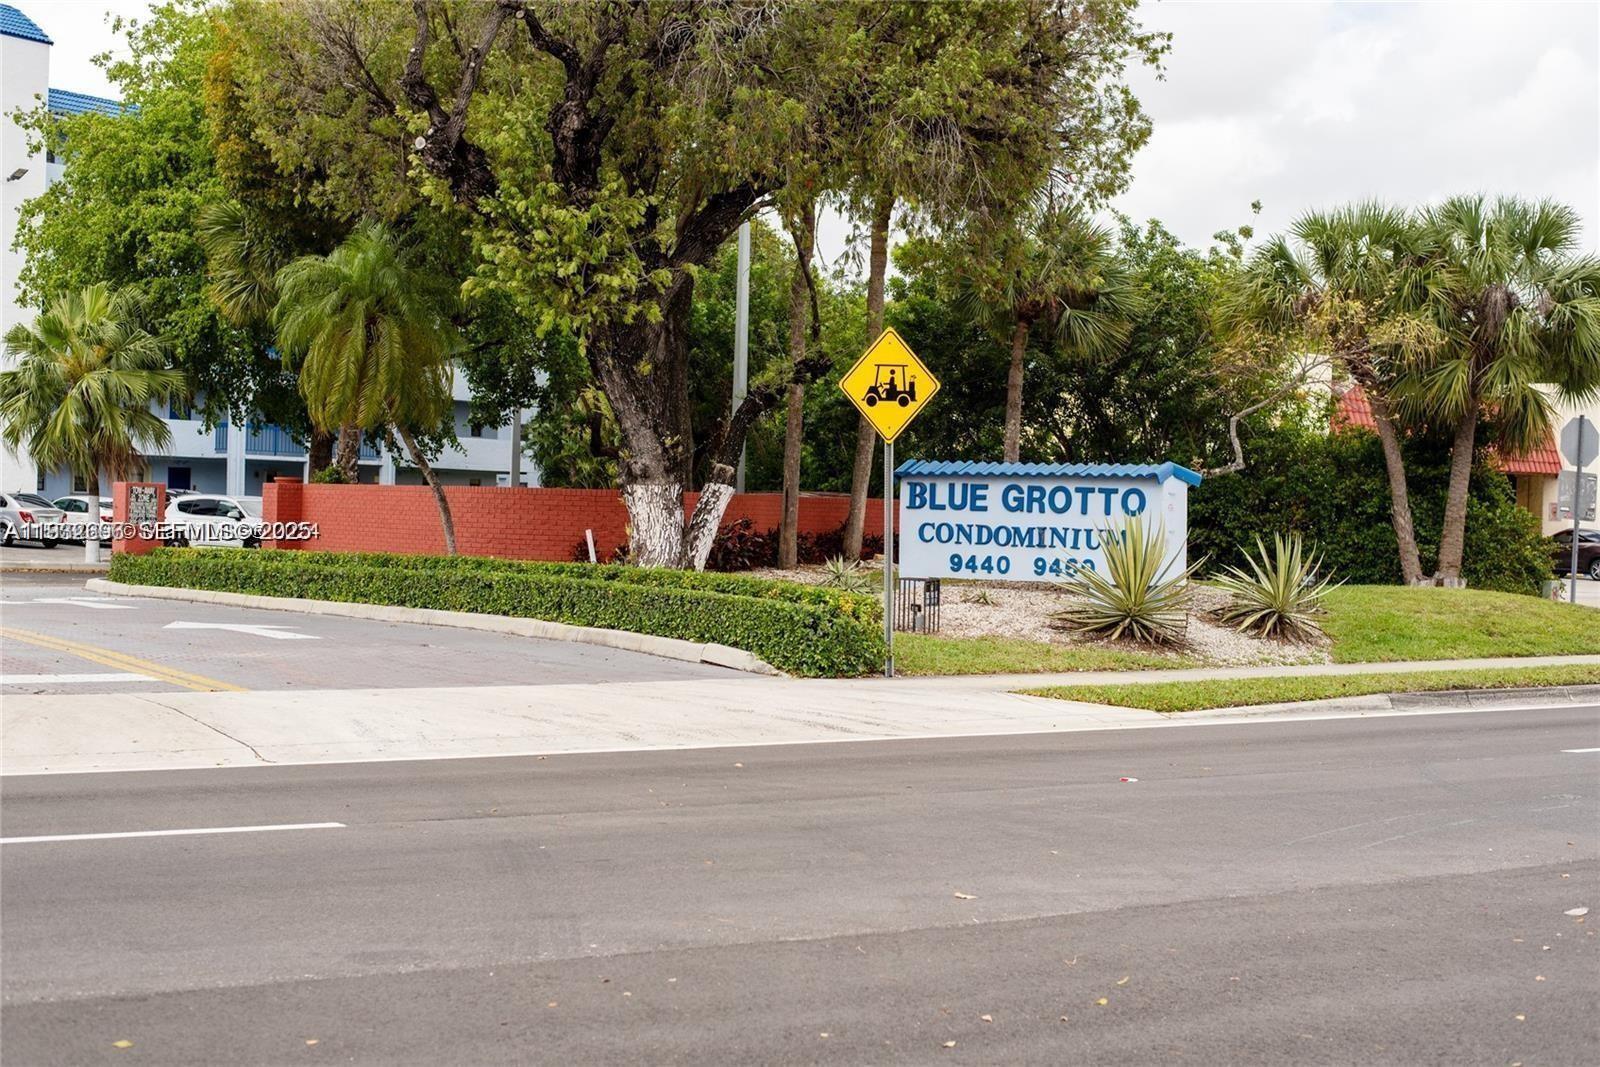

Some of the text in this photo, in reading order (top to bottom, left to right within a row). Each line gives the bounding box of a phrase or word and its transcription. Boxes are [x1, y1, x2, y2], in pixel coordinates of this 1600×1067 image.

[906, 481, 1147, 517] BLUE GROTTO
[949, 553, 1011, 575] 9440
